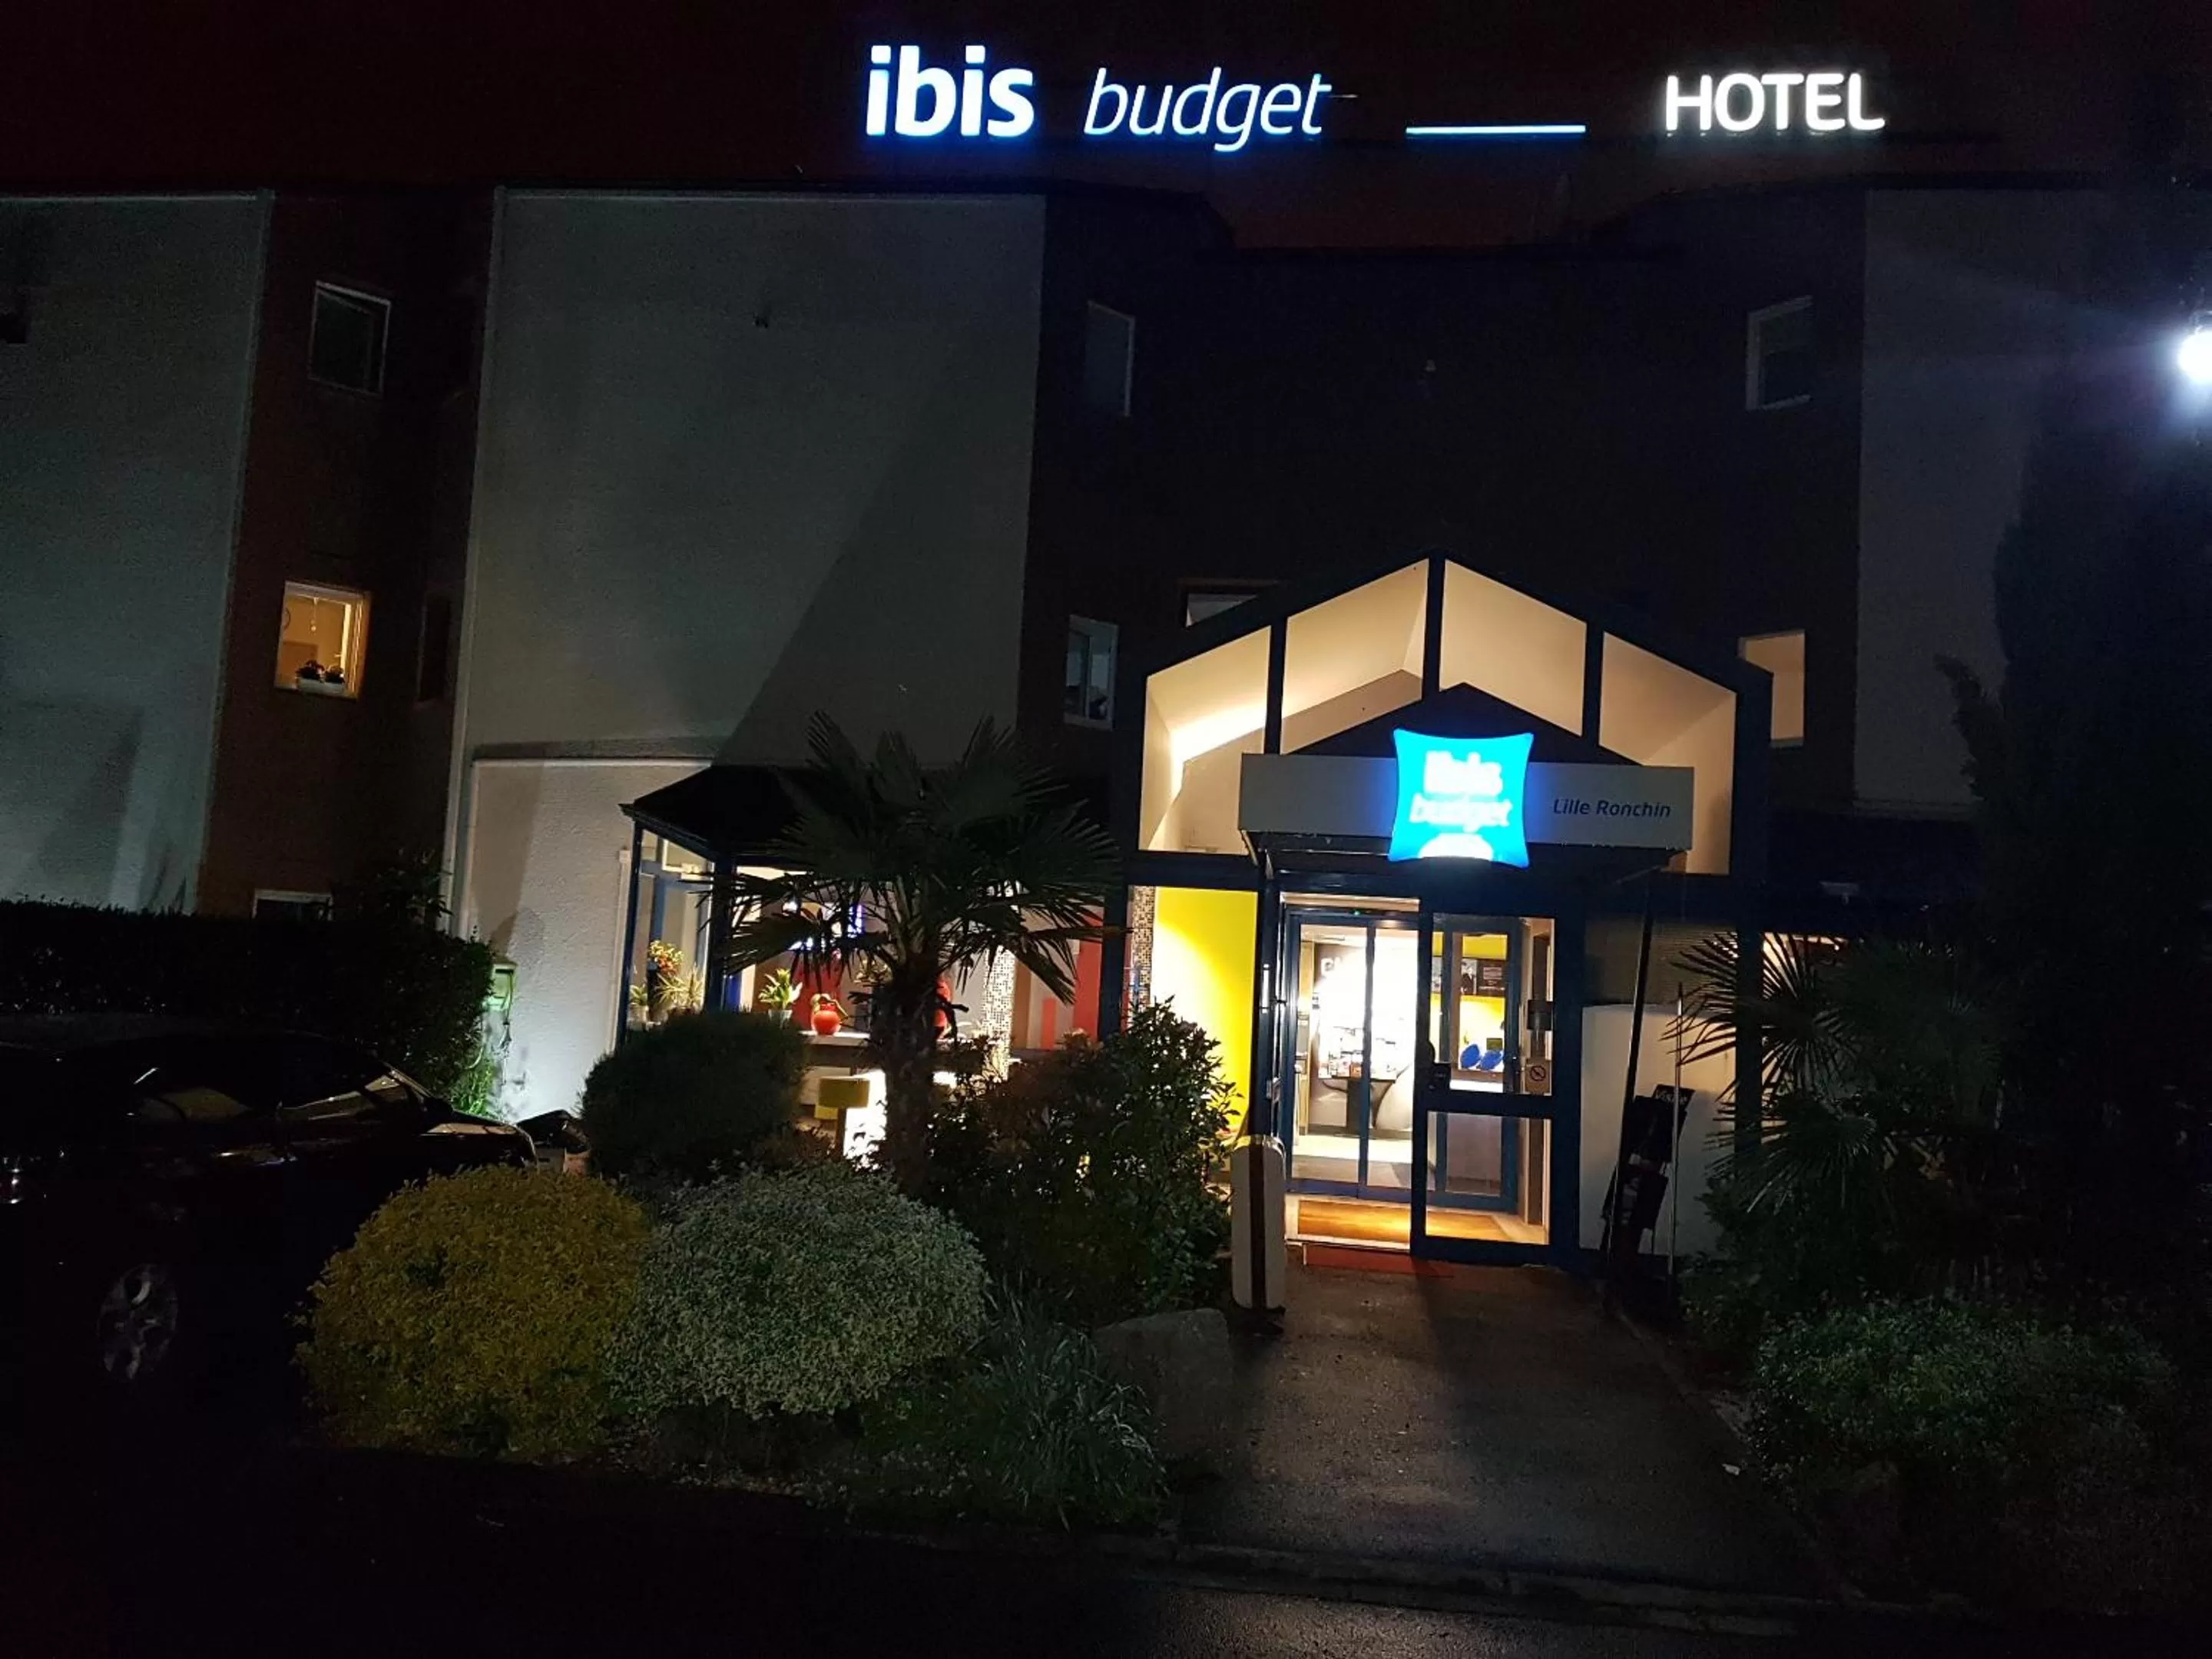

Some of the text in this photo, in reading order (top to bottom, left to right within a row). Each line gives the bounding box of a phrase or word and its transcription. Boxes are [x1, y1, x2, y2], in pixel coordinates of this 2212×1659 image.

[866, 45, 1333, 152] ibis budget
[1665, 73, 1886, 131] HOTEL
[1553, 798, 1671, 818] Lille Ronchin
